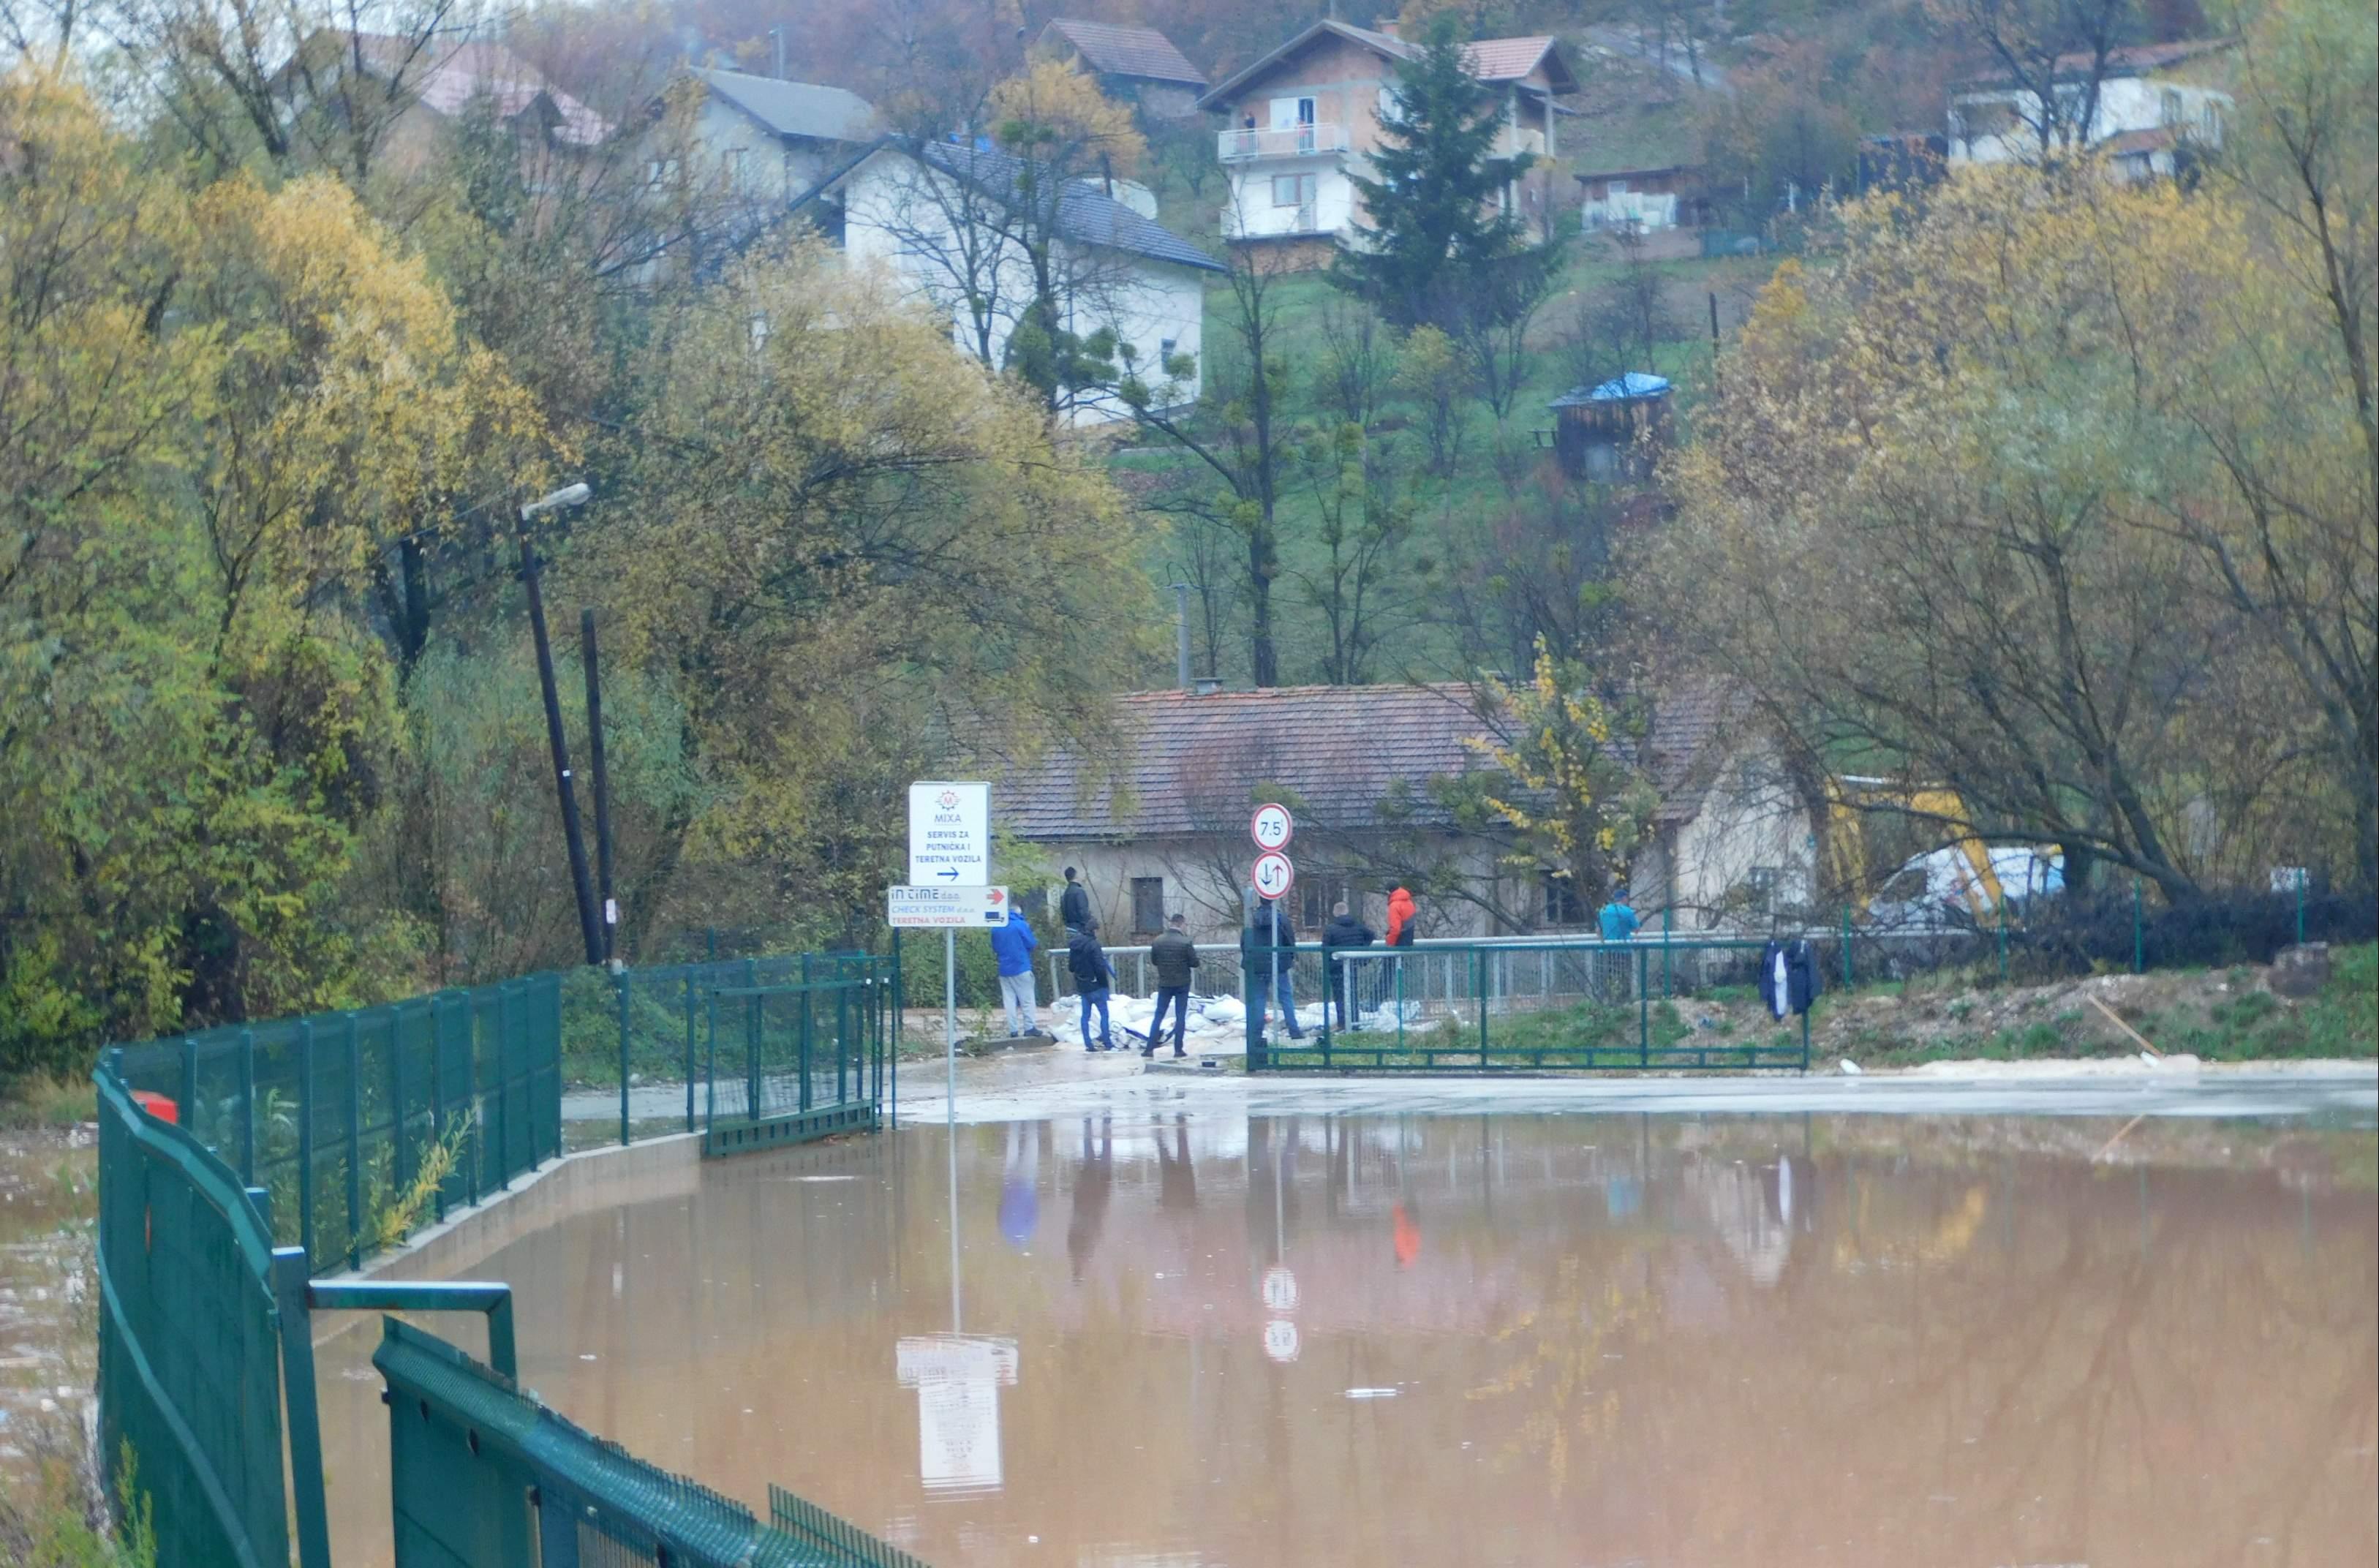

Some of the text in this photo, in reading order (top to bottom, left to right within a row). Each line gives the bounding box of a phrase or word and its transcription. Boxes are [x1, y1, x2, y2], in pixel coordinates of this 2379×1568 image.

[935, 814, 962, 823] MIXA
[891, 905, 920, 913] CHECK
[923, 905, 955, 913] SYSTEM
[892, 916, 965, 924] TERETNA VOZILA
